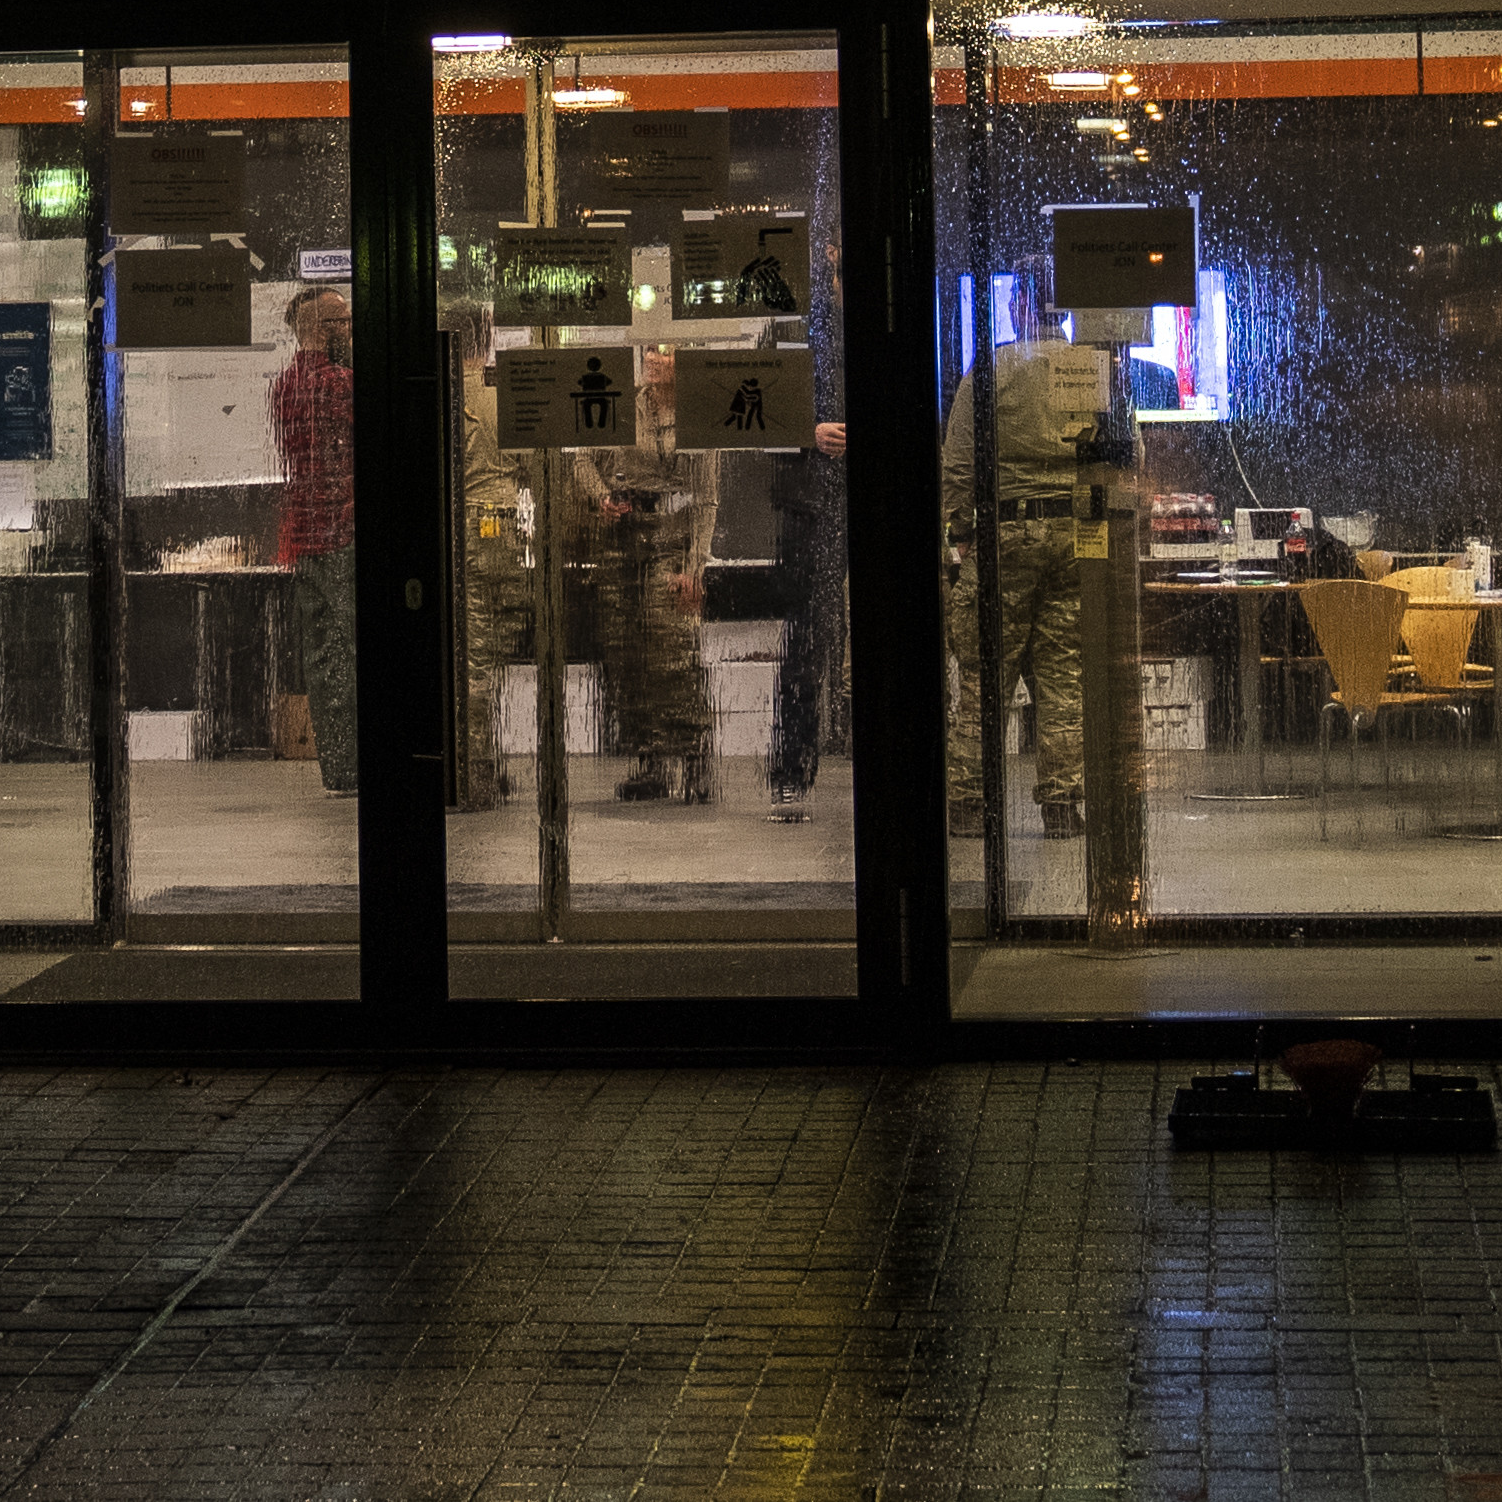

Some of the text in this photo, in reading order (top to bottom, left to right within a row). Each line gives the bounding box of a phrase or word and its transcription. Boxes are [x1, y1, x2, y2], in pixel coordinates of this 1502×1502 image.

[1071, 240, 1177, 253] Politiets Call Center
[131, 281, 234, 293] Politiets Call Center
[173, 296, 194, 308] JON
